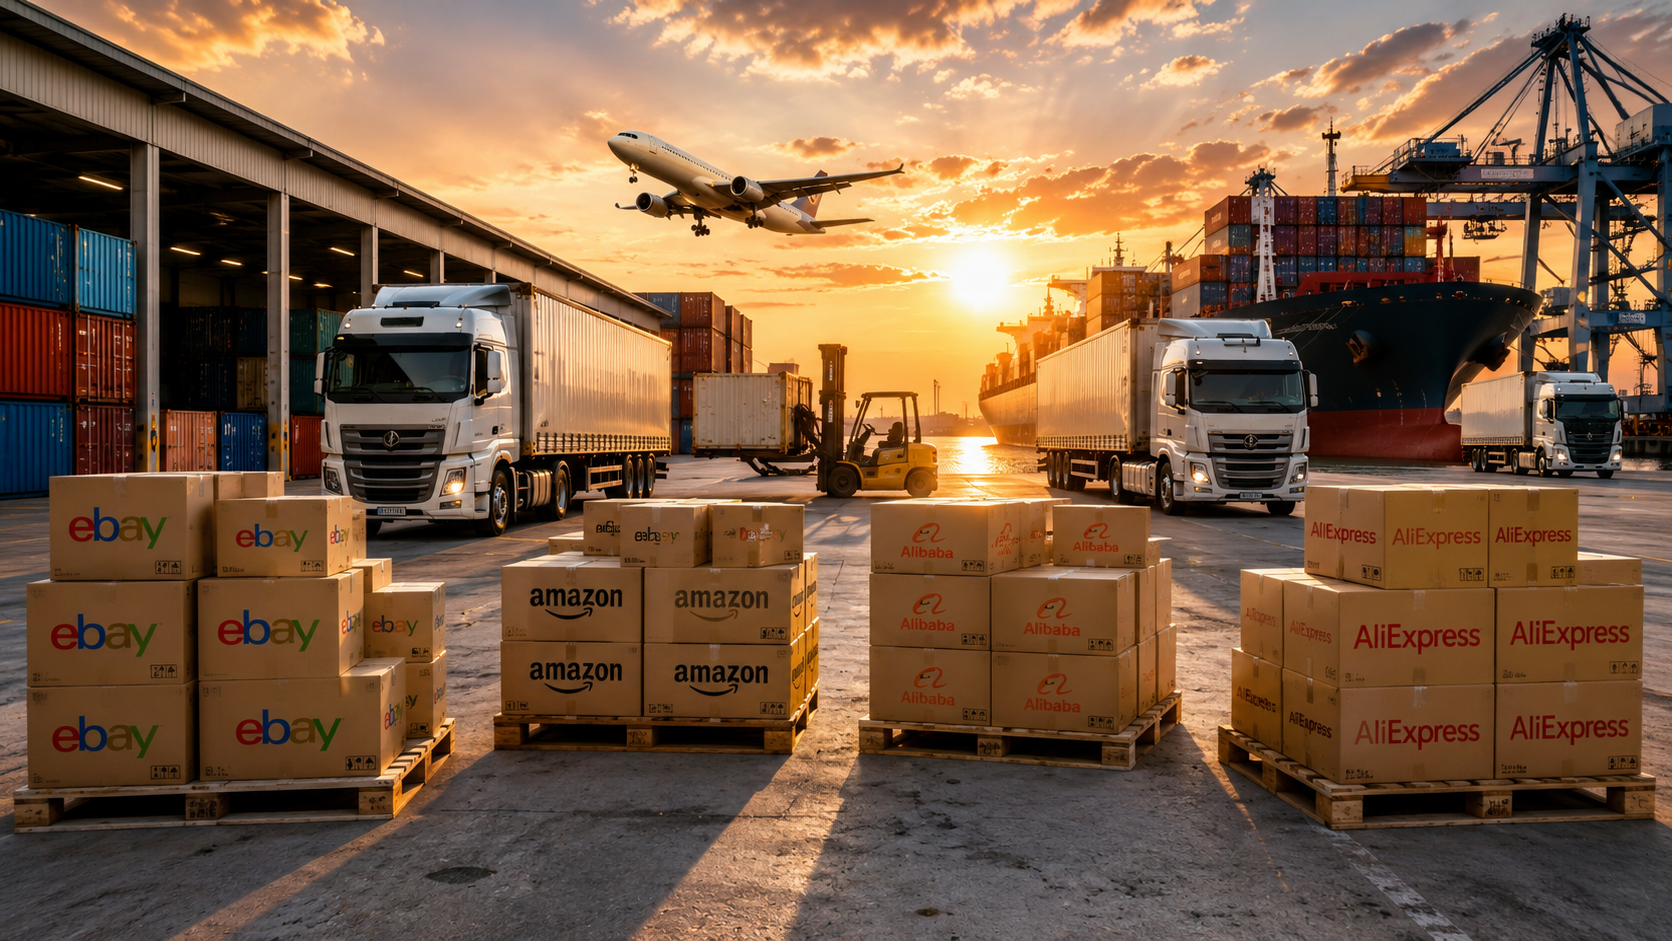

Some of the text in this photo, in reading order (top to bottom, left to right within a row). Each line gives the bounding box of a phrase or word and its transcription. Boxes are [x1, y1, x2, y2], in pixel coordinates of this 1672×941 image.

[69, 507, 167, 549] ebay
[236, 523, 308, 552] ebay
[1311, 522, 1376, 544] AliExpress
[1392, 527, 1481, 549] AliExpress
[1495, 526, 1571, 546] AliExpress
[901, 545, 953, 559] Alibaba
[1073, 541, 1119, 552] Alibaba
[530, 588, 622, 607] amazon
[675, 590, 768, 609] amazon
[51, 614, 157, 657] ebay
[218, 609, 320, 651] ebay
[372, 615, 418, 636] ebay
[900, 618, 955, 632] Alibaba
[1023, 622, 1081, 637] Alibaba
[1510, 620, 1630, 651] AliExpress
[1354, 623, 1480, 655] AliExpress
[530, 662, 622, 681] amazon
[674, 664, 768, 684] amazon
[901, 691, 955, 706] Alibaba
[1024, 698, 1081, 713] Alibaba
[52, 716, 158, 759] ebay
[236, 709, 341, 751] ebay
[1355, 719, 1480, 750] AliExpress
[1510, 715, 1629, 745] AliExpress
